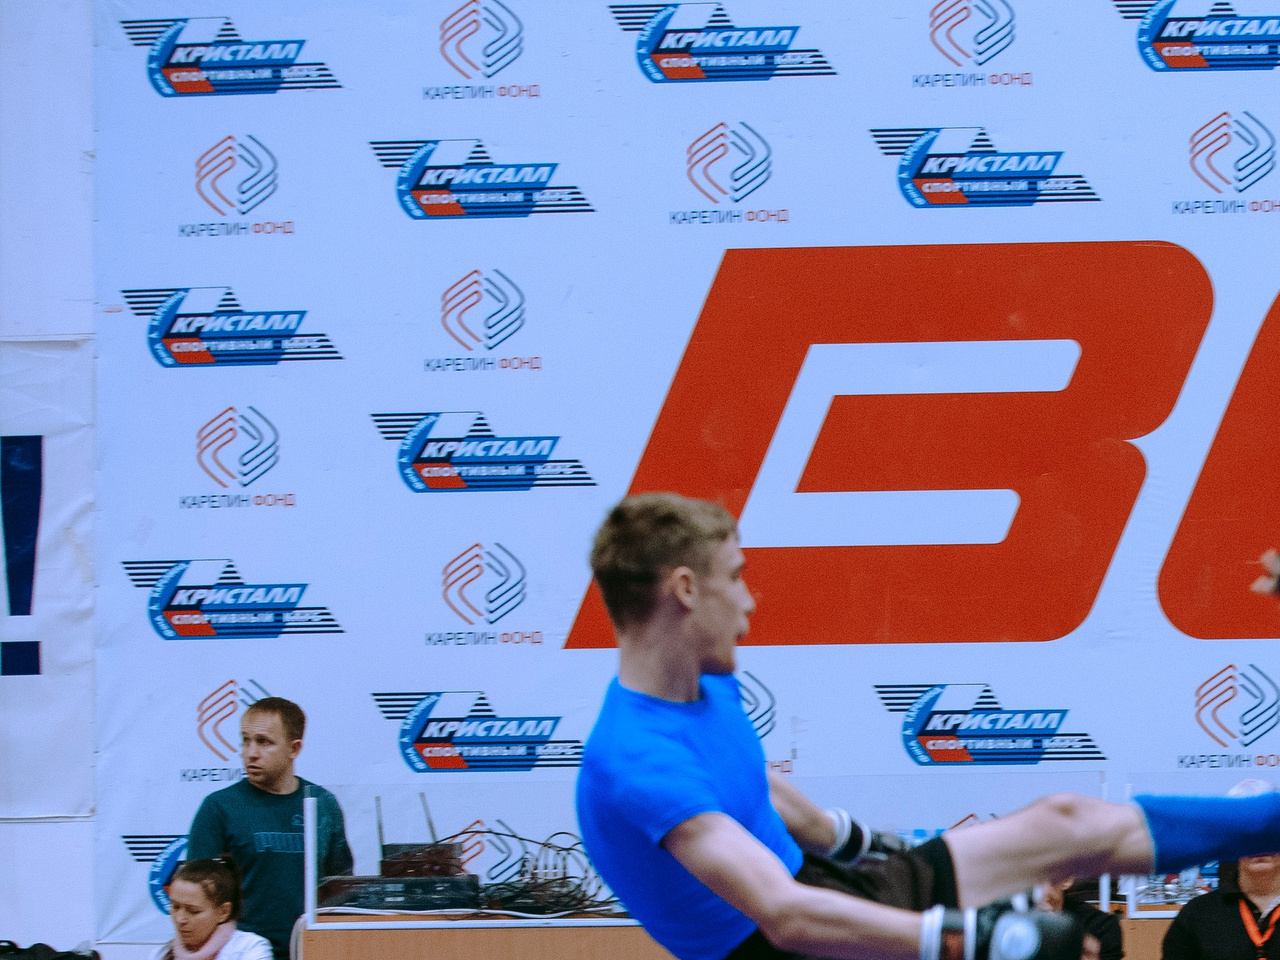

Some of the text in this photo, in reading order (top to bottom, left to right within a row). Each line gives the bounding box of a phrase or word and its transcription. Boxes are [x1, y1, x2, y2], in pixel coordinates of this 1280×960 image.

[661, 30, 792, 48] КРИСТАЛЛ
[172, 44, 299, 62] КРИСТАЛЛ
[912, 72, 1033, 88] КАРЕЛИН ФОНД
[422, 84, 540, 100] КАРЕЛИН ФОНД
[921, 156, 1056, 174] КРИСТАЛЛ
[421, 166, 552, 185] КРИСТАЛЛ
[1172, 199, 1246, 214] КАРЕЛИН
[669, 208, 789, 224] КАРЕЛИН ФОНД
[178, 221, 295, 237] КАРЕЛИН ФОНД
[172, 314, 299, 333] КРИСТАЛЛ
[424, 356, 542, 372] КАРЕЛИН ФОНД
[421, 440, 552, 458] КРИСТАЛЛ
[179, 493, 296, 509] КАРЕЛИН ФОНД
[171, 588, 302, 606] КРИСТАЛЛ
[425, 630, 544, 646] КАРЕЛИН ФОНД
[423, 718, 554, 738] КРИСТАЛЛ
[926, 712, 1061, 732] КРИСТАЛЛ
[1178, 754, 1252, 769] КАРЕЛИН
